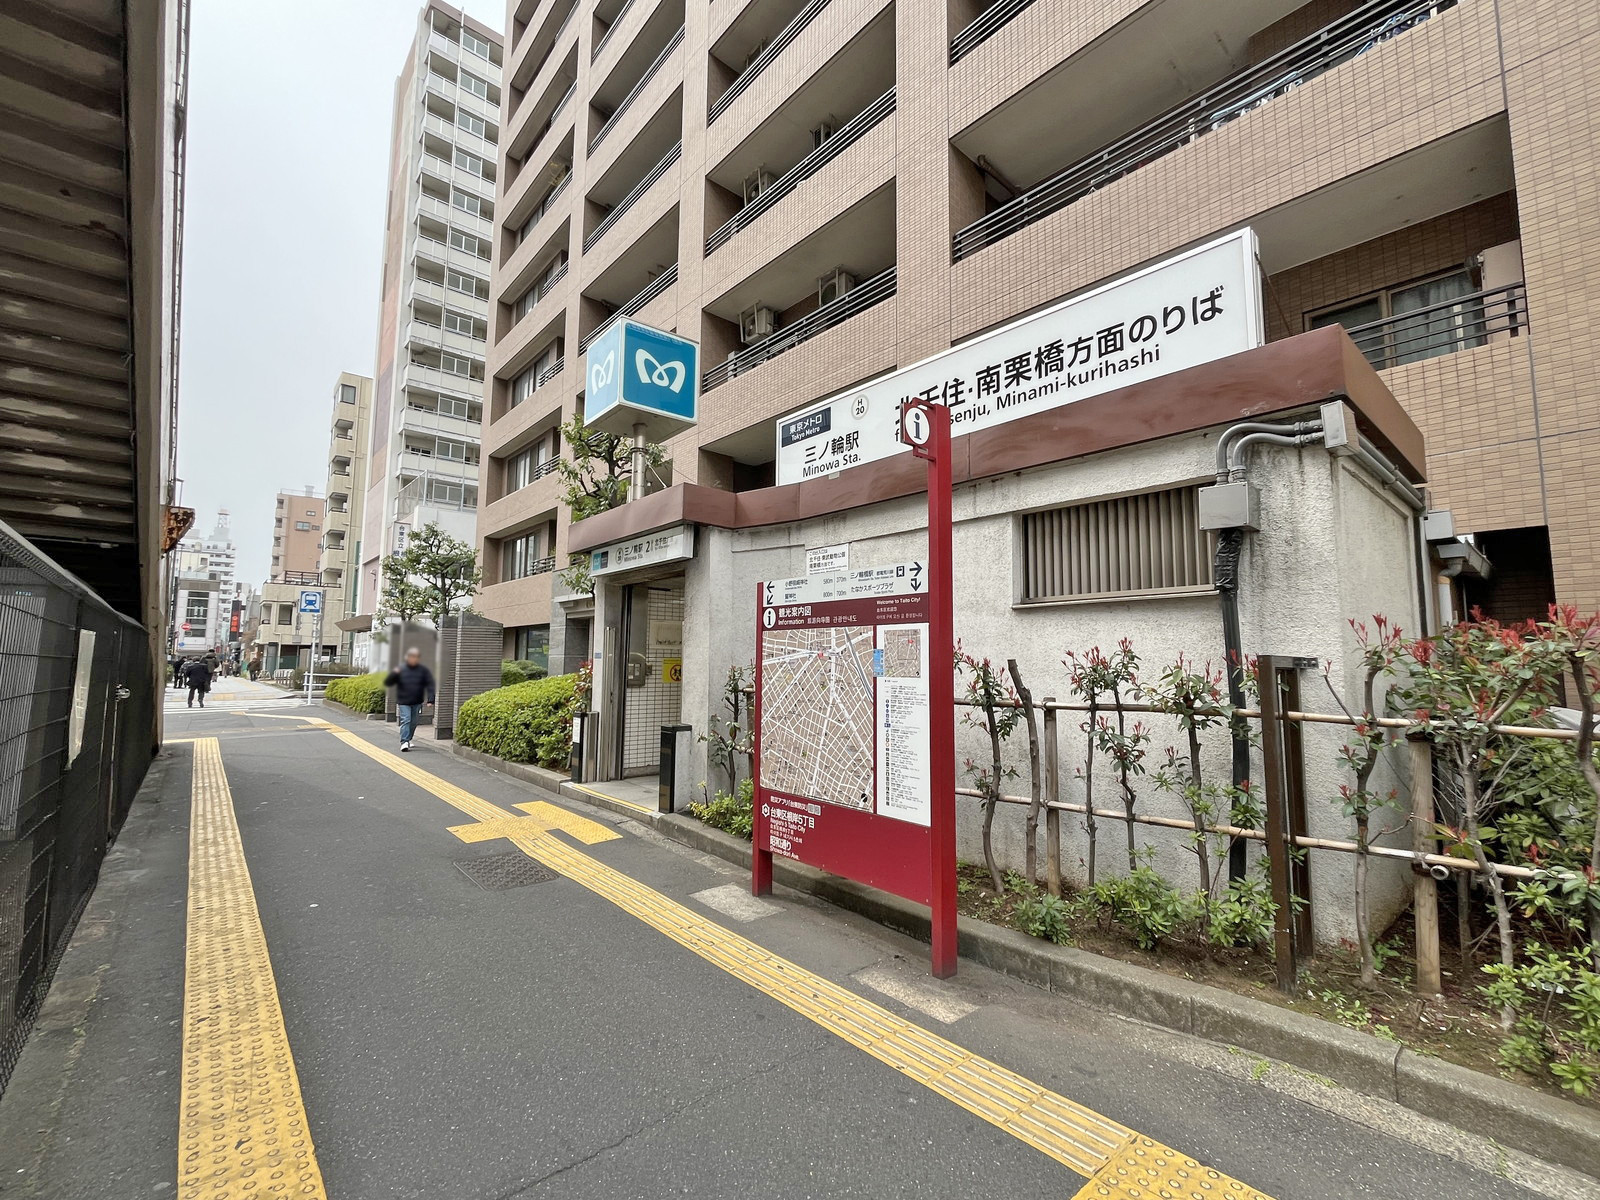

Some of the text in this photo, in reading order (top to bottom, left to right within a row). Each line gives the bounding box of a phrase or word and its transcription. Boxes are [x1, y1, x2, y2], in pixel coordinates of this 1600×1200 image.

[997, 344, 1160, 411] Minami-kurihashi
[855, 406, 865, 415] 20
[789, 414, 822, 434] 東京メトロ
[791, 426, 820, 441] Tokyo Metro
[805, 431, 859, 464] 三ノ輪駅
[802, 453, 861, 477] Minowa Sta.
[778, 605, 812, 618] 観光案内図
[778, 618, 805, 626] Information
[771, 807, 814, 828] 台東区根岸5丁目
